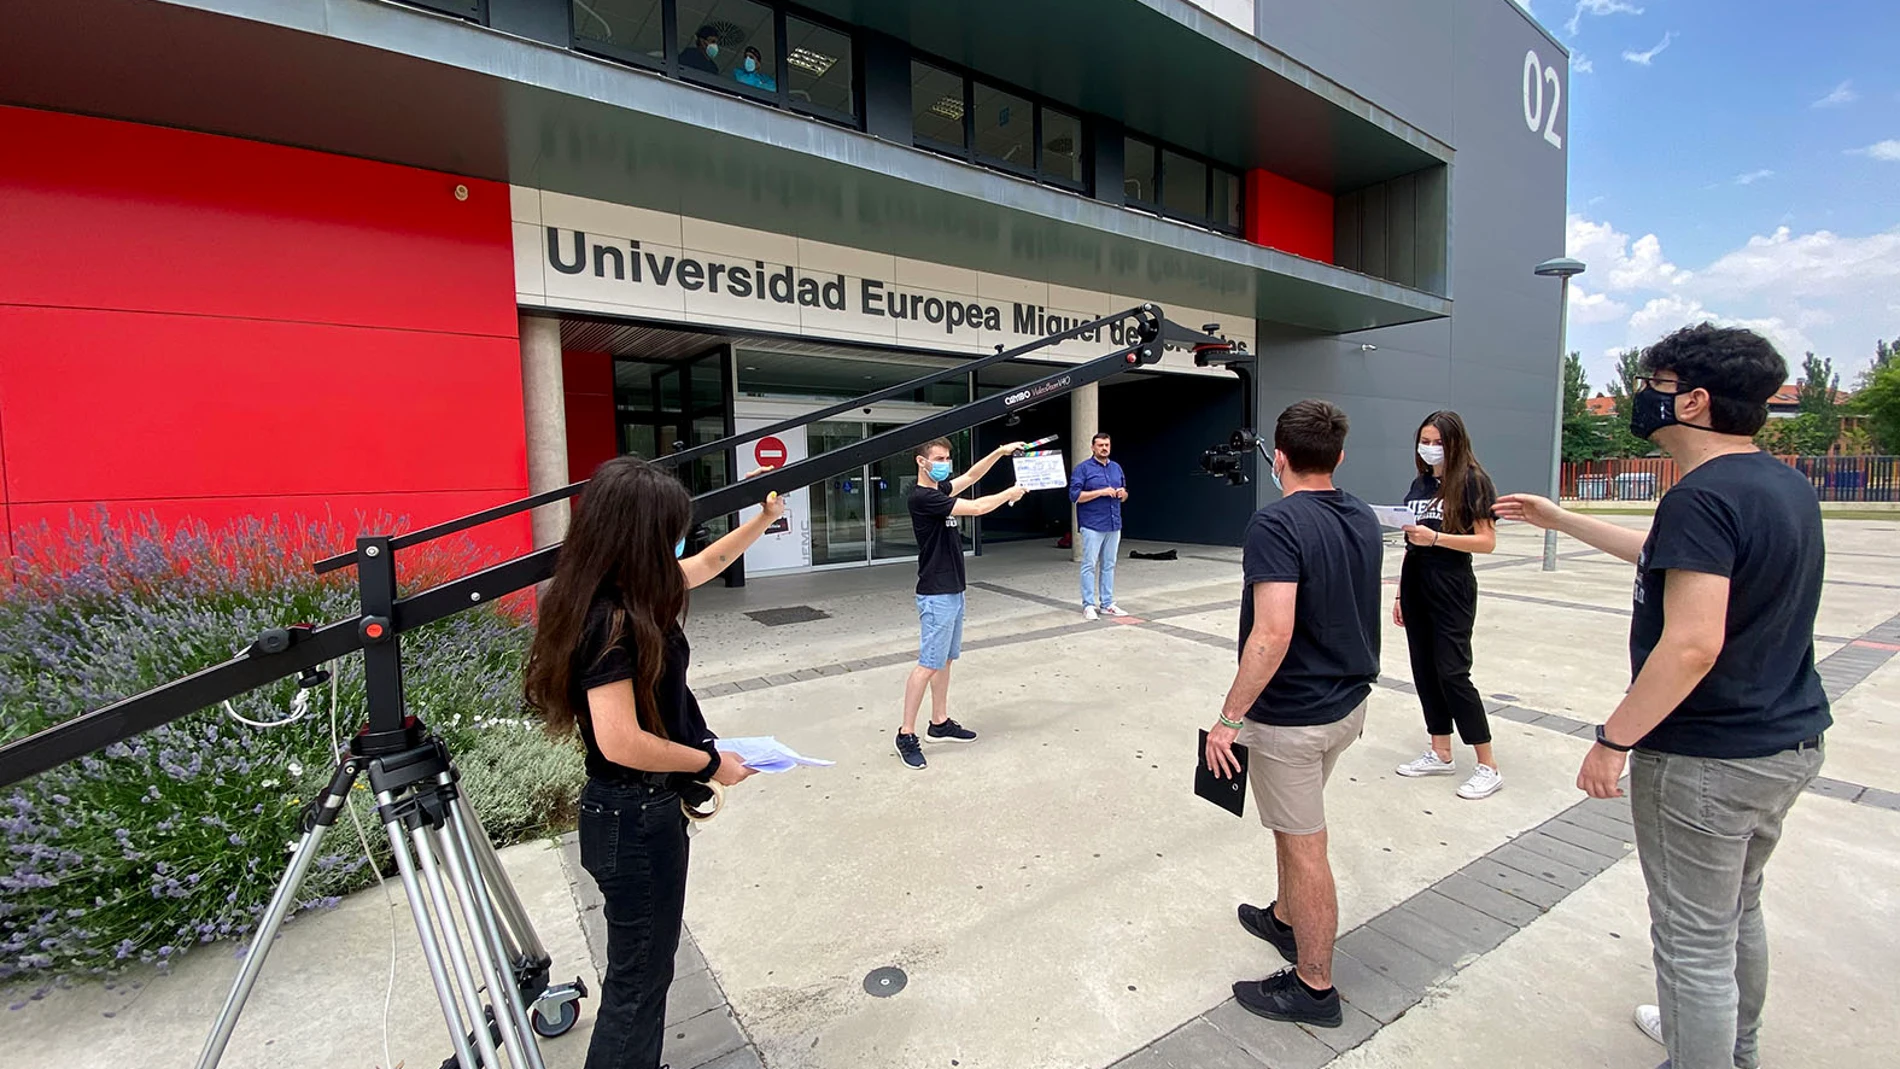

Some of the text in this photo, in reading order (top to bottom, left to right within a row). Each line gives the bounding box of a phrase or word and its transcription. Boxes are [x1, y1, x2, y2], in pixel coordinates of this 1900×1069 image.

[1523, 50, 1561, 149] 02
[547, 226, 846, 311] Universidad
[861, 278, 1001, 334] Europea
